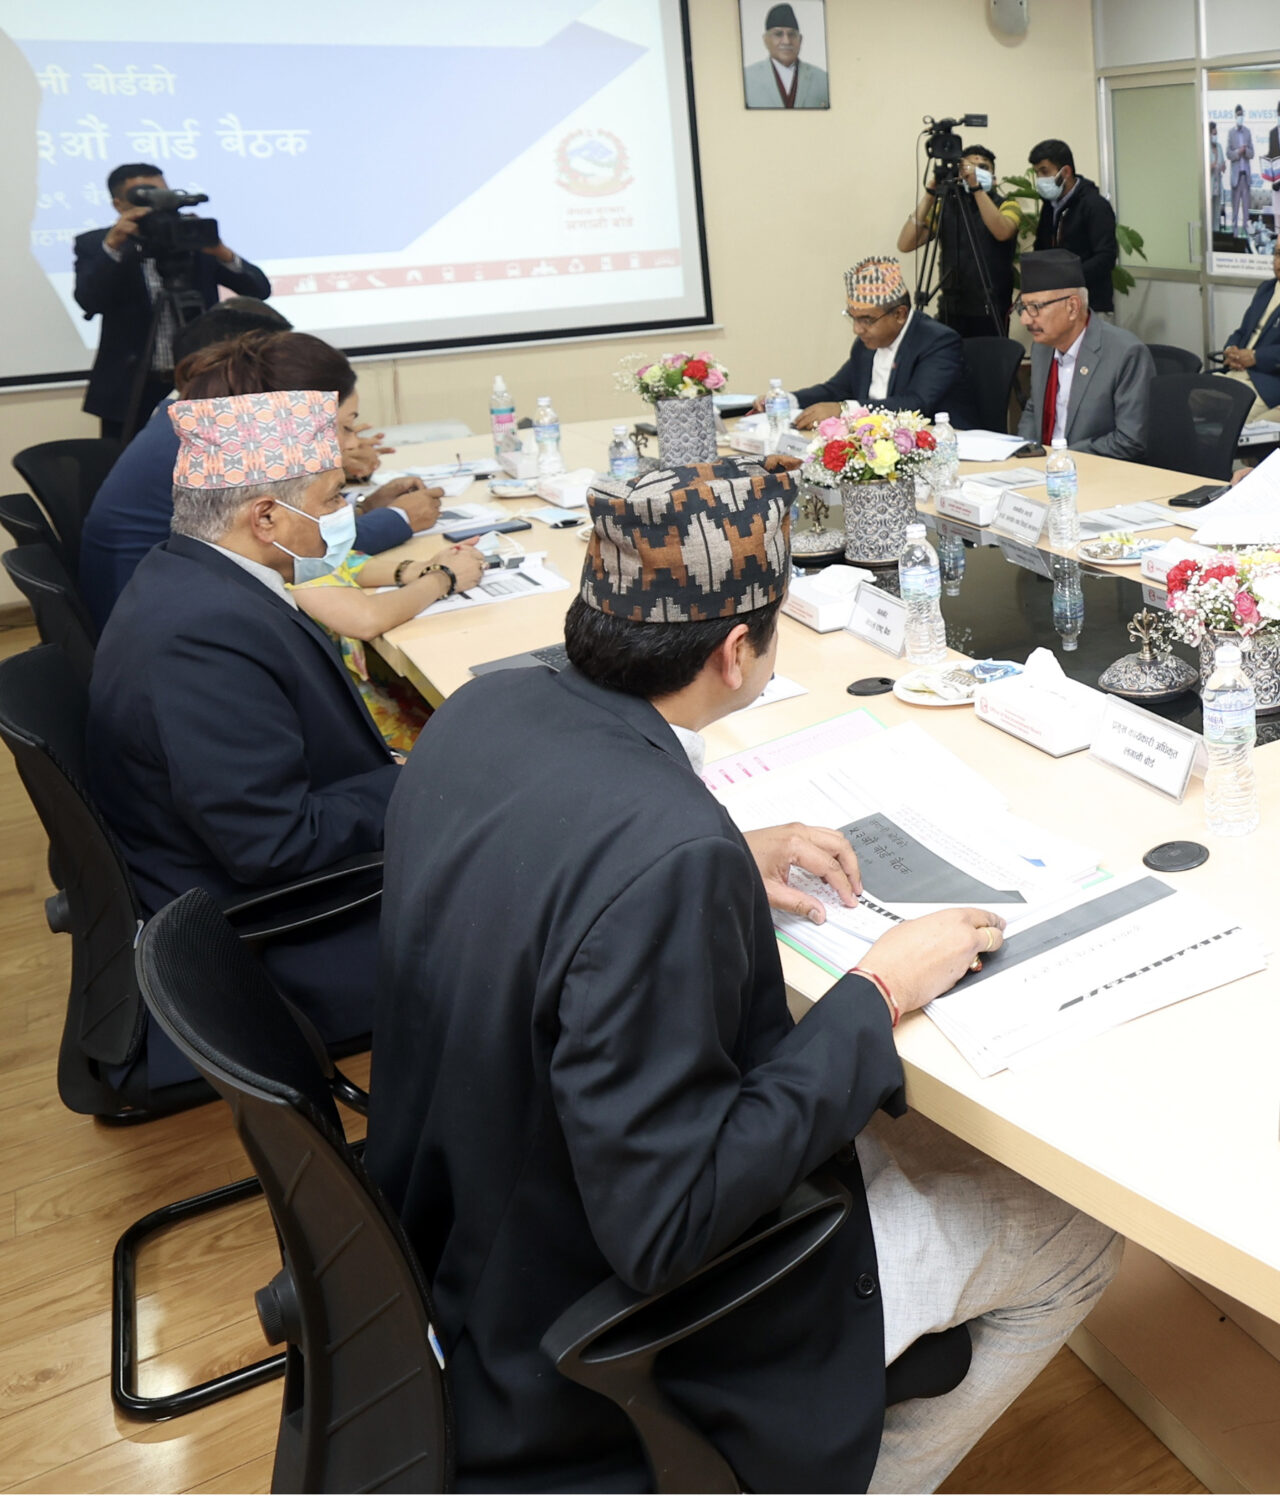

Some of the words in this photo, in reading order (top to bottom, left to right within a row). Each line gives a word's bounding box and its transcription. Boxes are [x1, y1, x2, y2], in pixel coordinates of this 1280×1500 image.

[81, 64, 177, 95] बोर्डको
[125, 118, 202, 160] बोर्ड
[215, 112, 310, 158] बैठक
